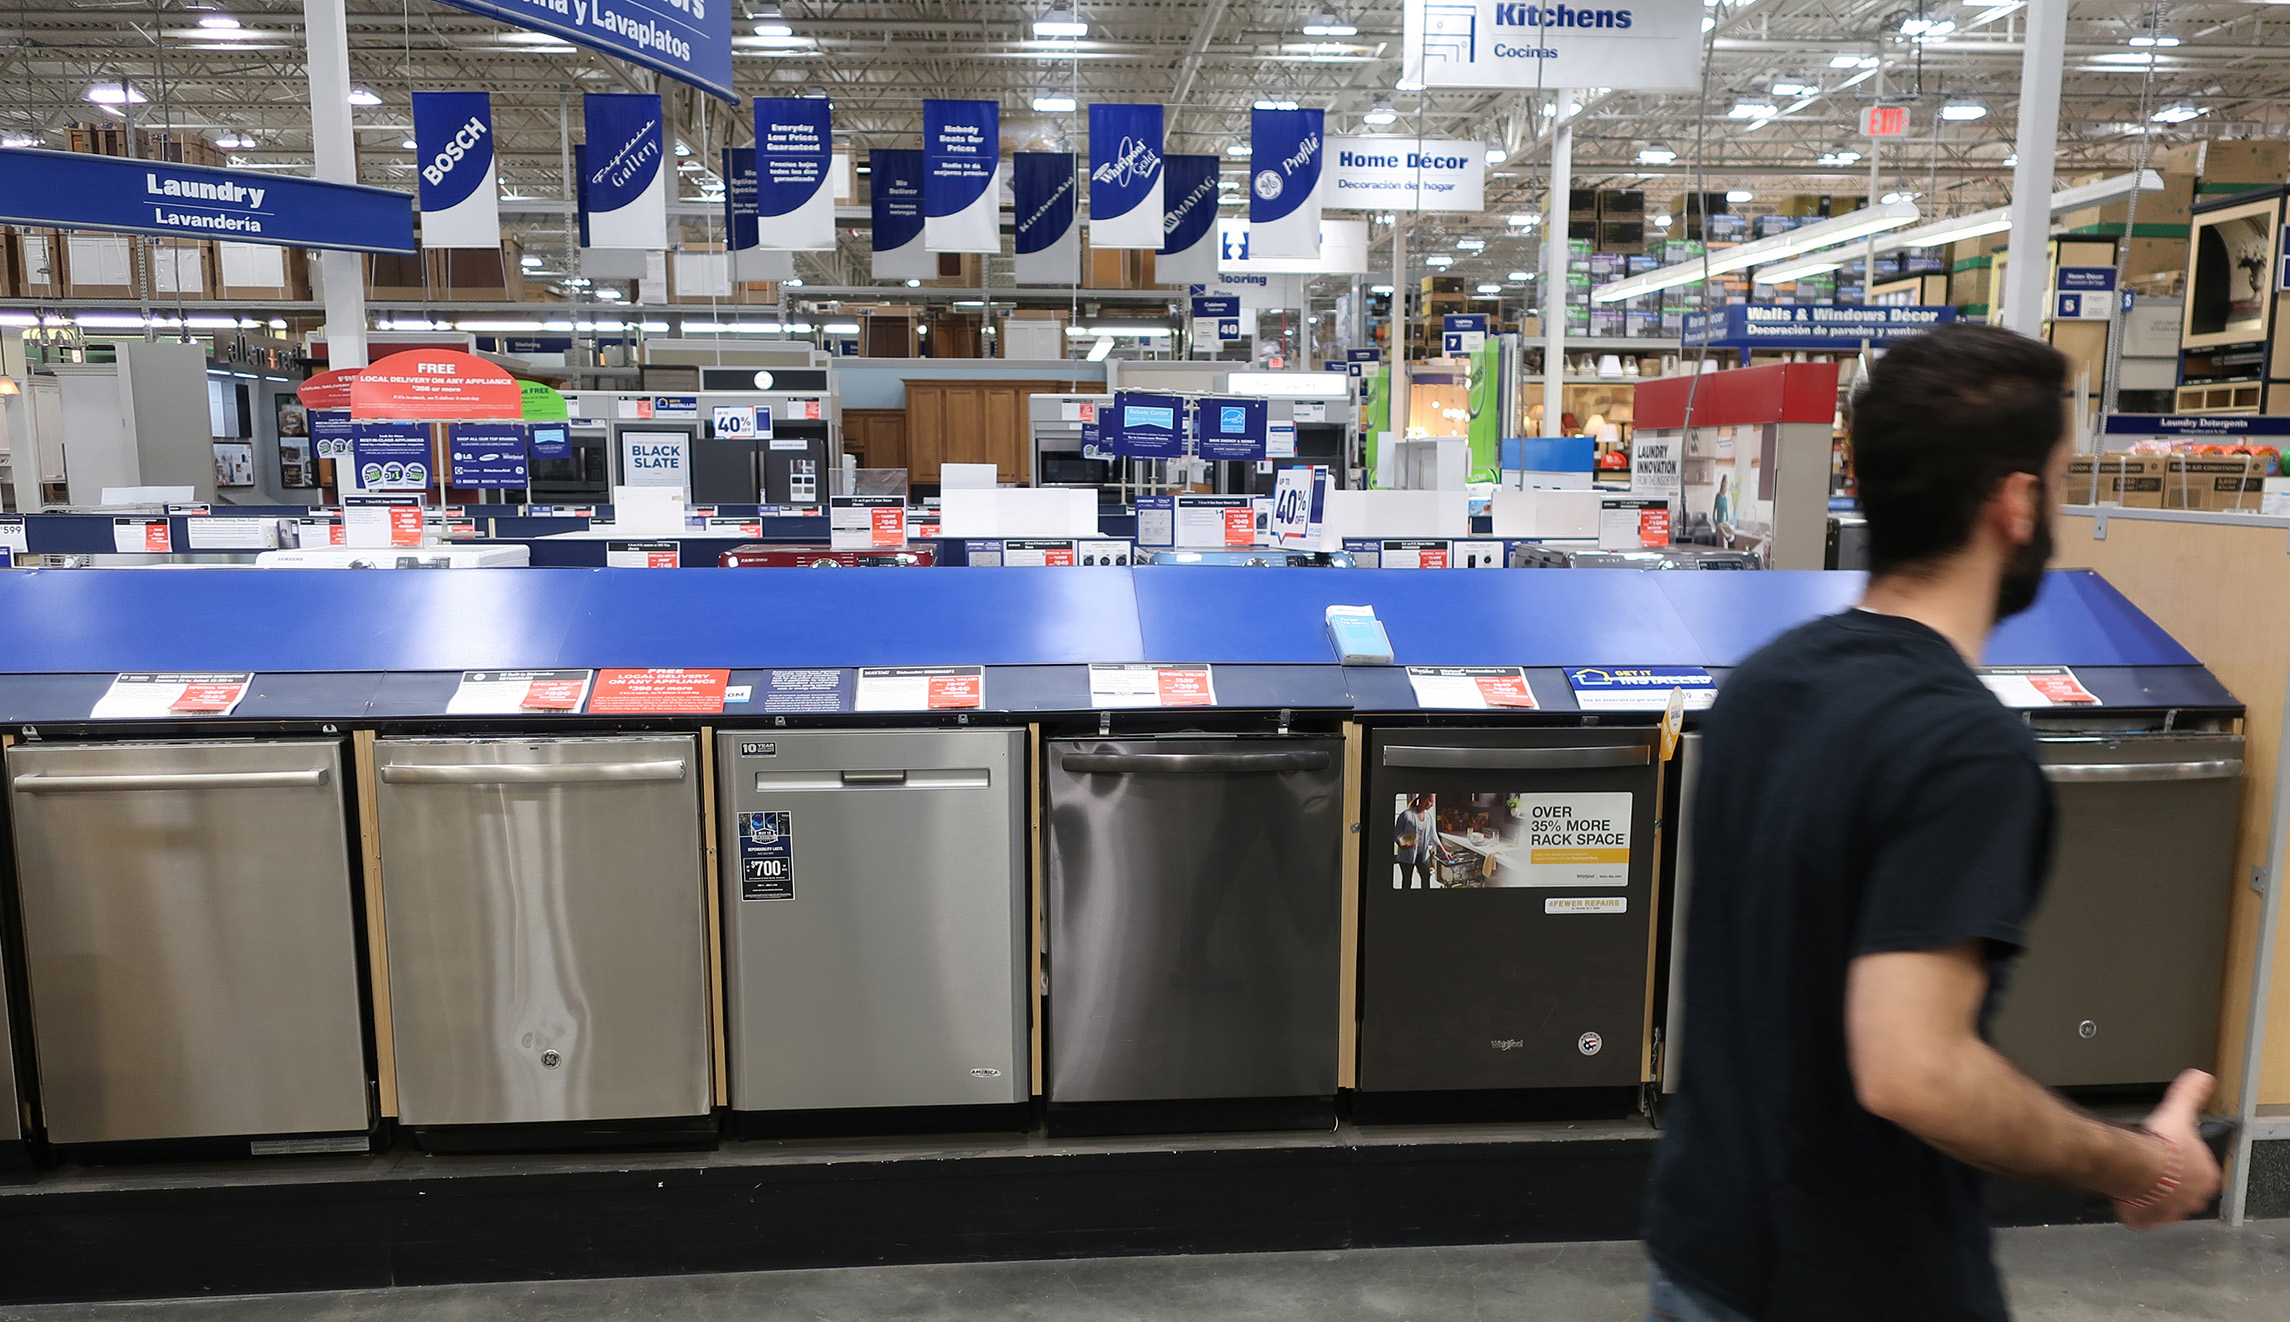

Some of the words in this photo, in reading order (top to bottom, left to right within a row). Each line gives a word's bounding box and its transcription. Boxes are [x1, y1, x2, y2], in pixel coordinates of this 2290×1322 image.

[1496, 3, 1633, 28] Kitchens
[575, 0, 587, 25] y
[592, 0, 691, 61] Lavaplatos
[1494, 43, 1558, 58] Cocinas
[1869, 108, 1905, 135] EXIT
[771, 124, 814, 133] Everyday
[944, 125, 979, 135] Nobody
[422, 116, 487, 186] BOSCH
[767, 143, 820, 151] Guaranteed
[1282, 132, 1321, 176] Profile
[1340, 151, 1399, 168] Home
[1407, 152, 1469, 169] Décor
[611, 138, 658, 188] Gallery
[1097, 138, 1147, 185] Whirlpool
[1132, 148, 1156, 175] Gold
[147, 173, 265, 209] Laundry
[1338, 179, 1401, 190] Decoración
[1423, 181, 1455, 192] hogar
[1019, 176, 1075, 232] KitchenAid
[1174, 176, 1216, 223] MAYTAG
[155, 208, 262, 232] Lavandería
[2065, 299, 2076, 311] 5
[1747, 307, 1792, 321] Walls
[1795, 308, 1808, 321] &
[1813, 307, 1886, 322] Windows
[1890, 307, 1938, 323] Décor
[1220, 324, 1238, 335] 40
[1747, 324, 1811, 336] Decoración
[1813, 324, 1828, 336] de
[1829, 326, 1876, 338] paredes
[1877, 327, 1885, 338] y
[1449, 338, 1458, 348] 7
[418, 363, 456, 375] FREE
[360, 375, 389, 383] LOCAL
[390, 376, 431, 384] DELIVERY
[465, 378, 512, 386] APPLIANCE
[2160, 417, 2198, 428] Laundry
[2200, 418, 2248, 428] Detergents
[632, 445, 681, 457] BLACK
[1637, 445, 1669, 459] LAUNDRY
[634, 457, 679, 469] SLATE
[1637, 461, 1677, 474] INNOVATION
[1276, 490, 1306, 524] 40%
[1618, 676, 1712, 685] INSTALLED
[743, 744, 757, 753] 10
[1532, 806, 1572, 818] OVER
[1531, 820, 1561, 832] 35%
[1566, 819, 1611, 831] MORE
[1531, 834, 1571, 845] RACK
[1577, 833, 1624, 845] SPACE
[751, 860, 781, 876] $700
[1584, 899, 1620, 907] REPAIRS
[1490, 1039, 1524, 1051] Whirlpool
